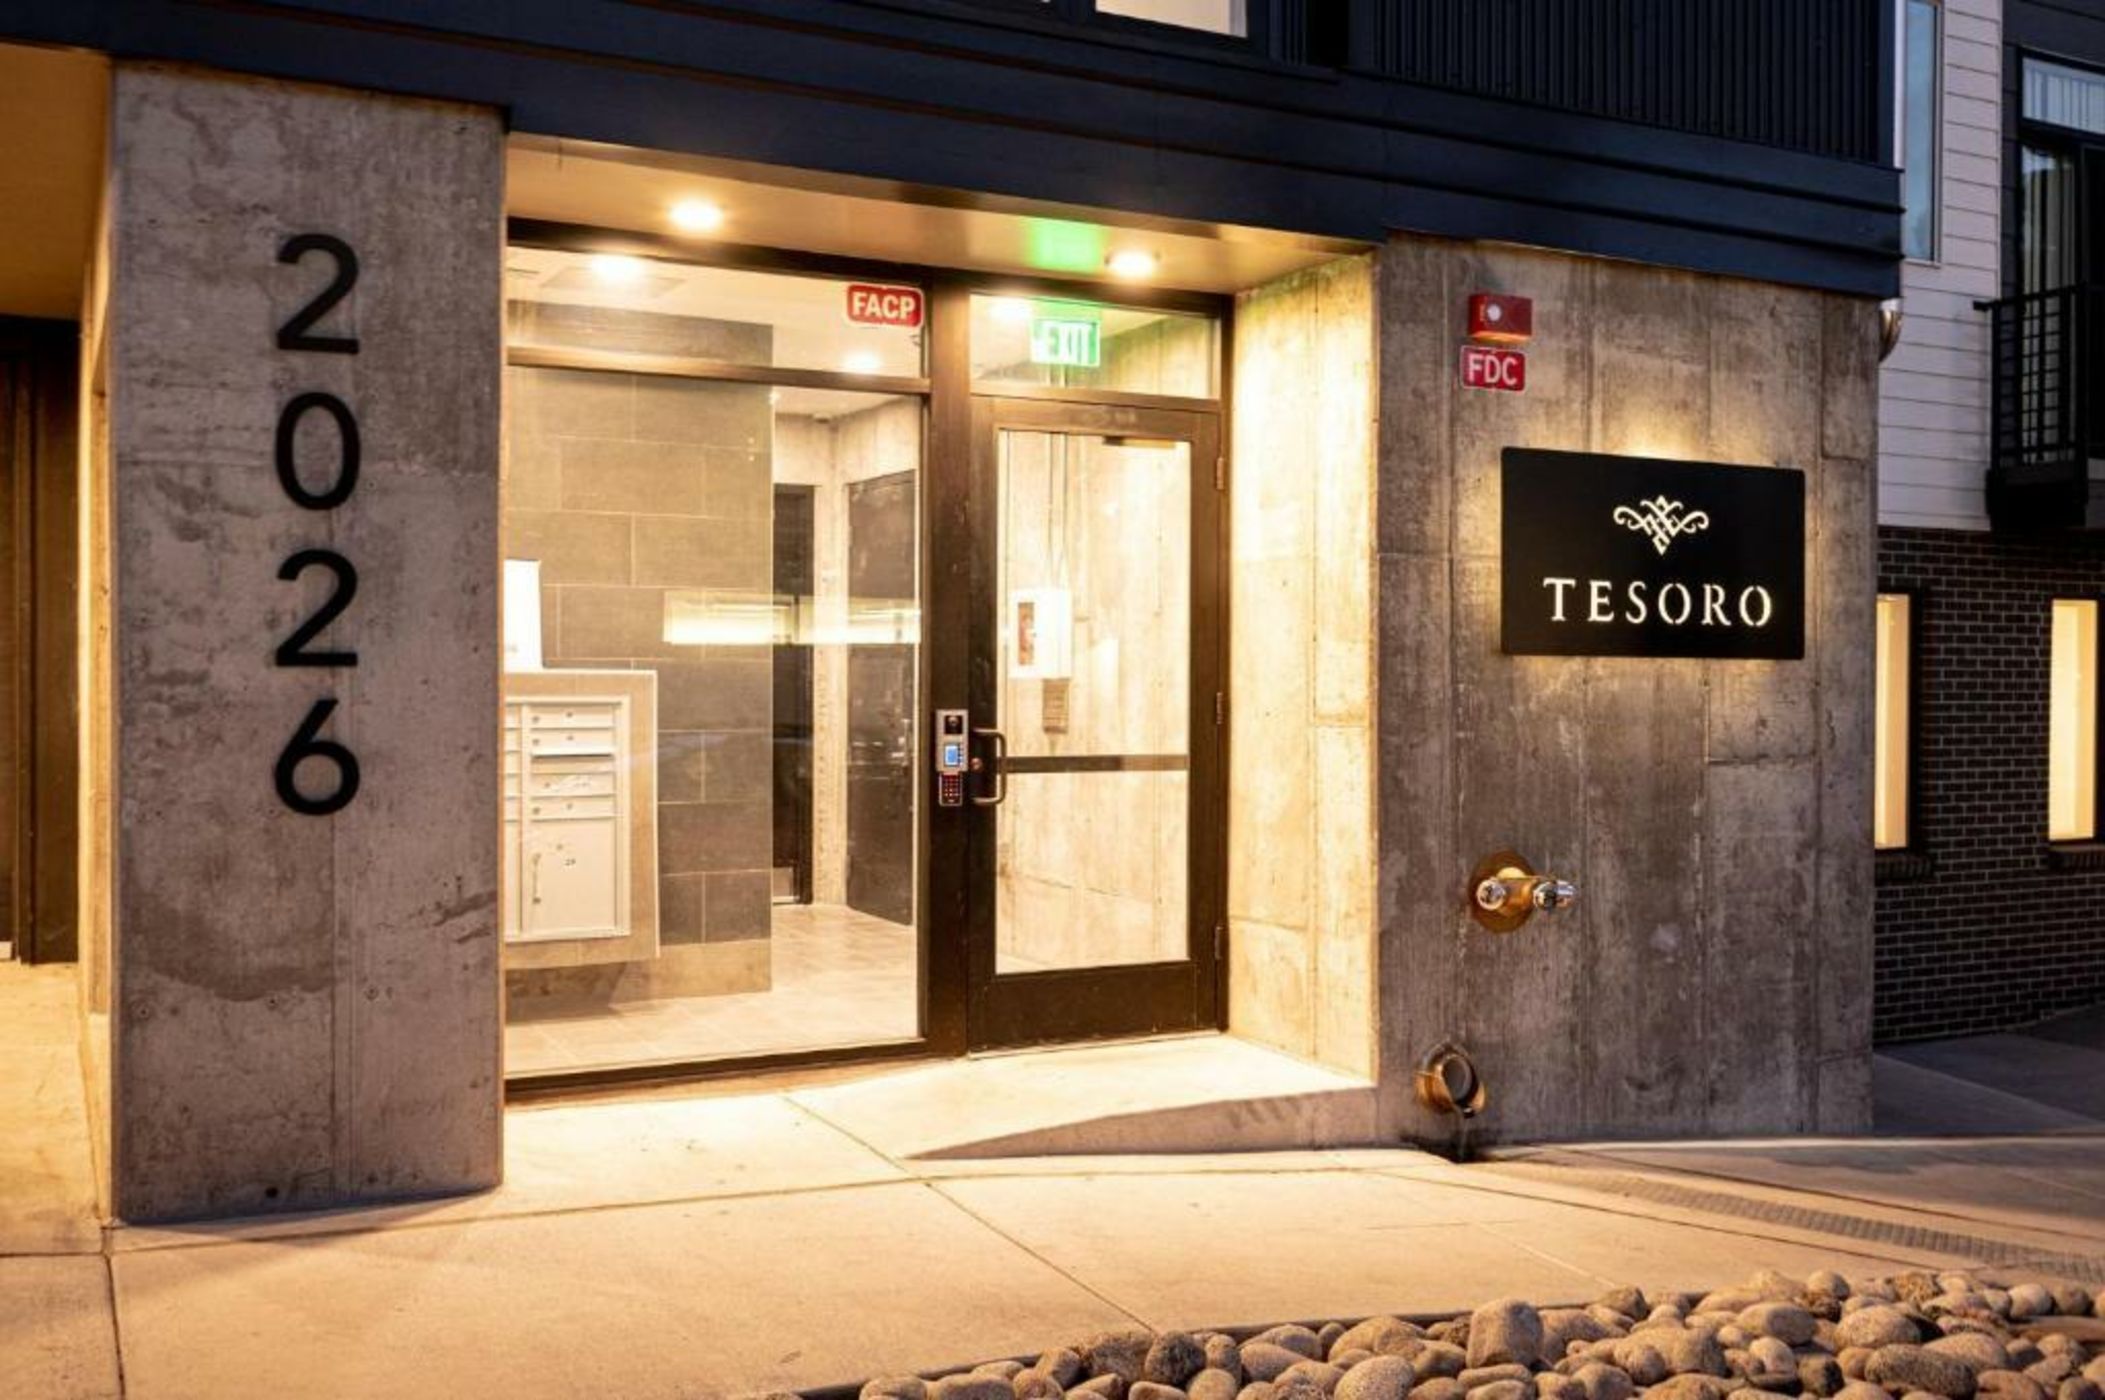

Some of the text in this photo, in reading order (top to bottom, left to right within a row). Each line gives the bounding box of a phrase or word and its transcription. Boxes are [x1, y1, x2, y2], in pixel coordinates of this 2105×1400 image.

[852, 291, 916, 320] FACP
[1040, 320, 1091, 365] EXIT
[1468, 353, 1518, 386] FDC
[273, 233, 360, 816] 2026
[1542, 576, 1774, 627] TESORO
